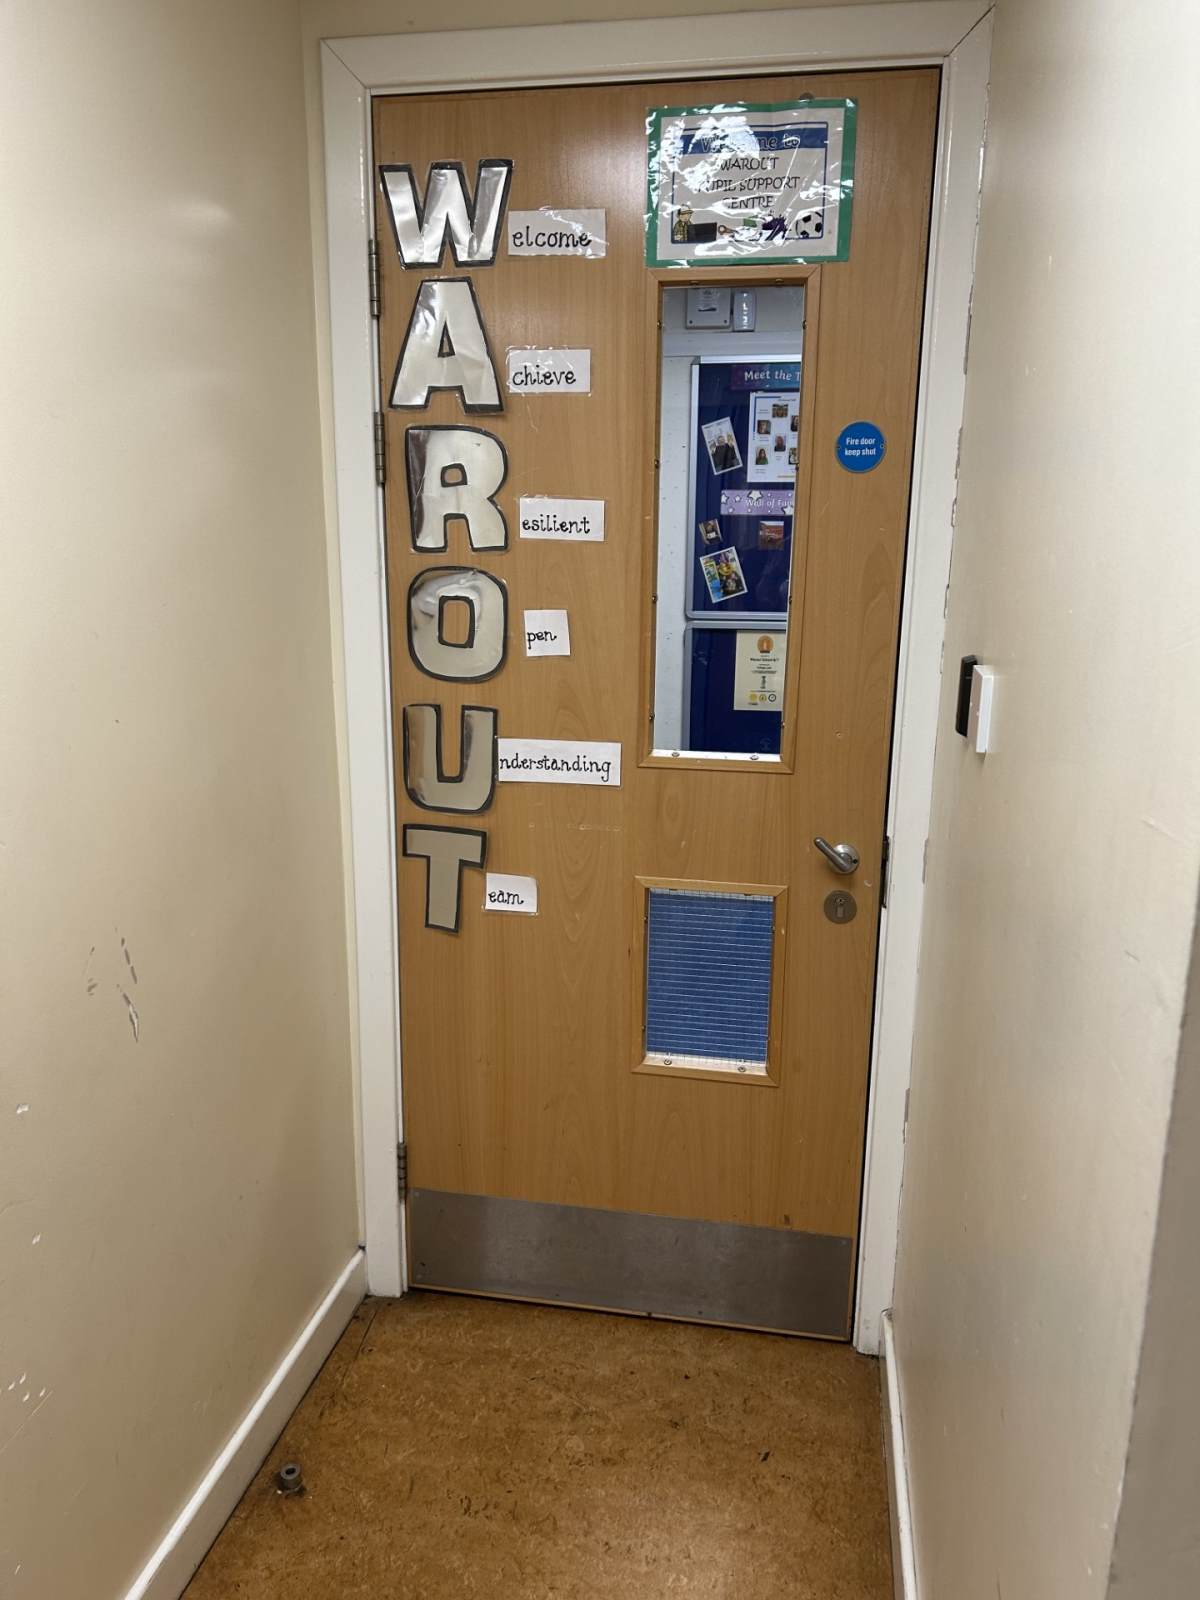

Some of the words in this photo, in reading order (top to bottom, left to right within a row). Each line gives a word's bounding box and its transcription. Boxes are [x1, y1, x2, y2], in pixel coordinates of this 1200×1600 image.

[698, 179, 737, 193] UPIL
[740, 176, 801, 192] SUPPORT
[744, 370, 771, 382] Meet
[775, 369, 792, 381] the
[846, 437, 859, 446] Fire
[860, 437, 876, 446] door
[845, 447, 860, 457] keep
[861, 447, 877, 456] shut
[527, 629, 557, 649] pen
[499, 752, 611, 782] nderstanding
